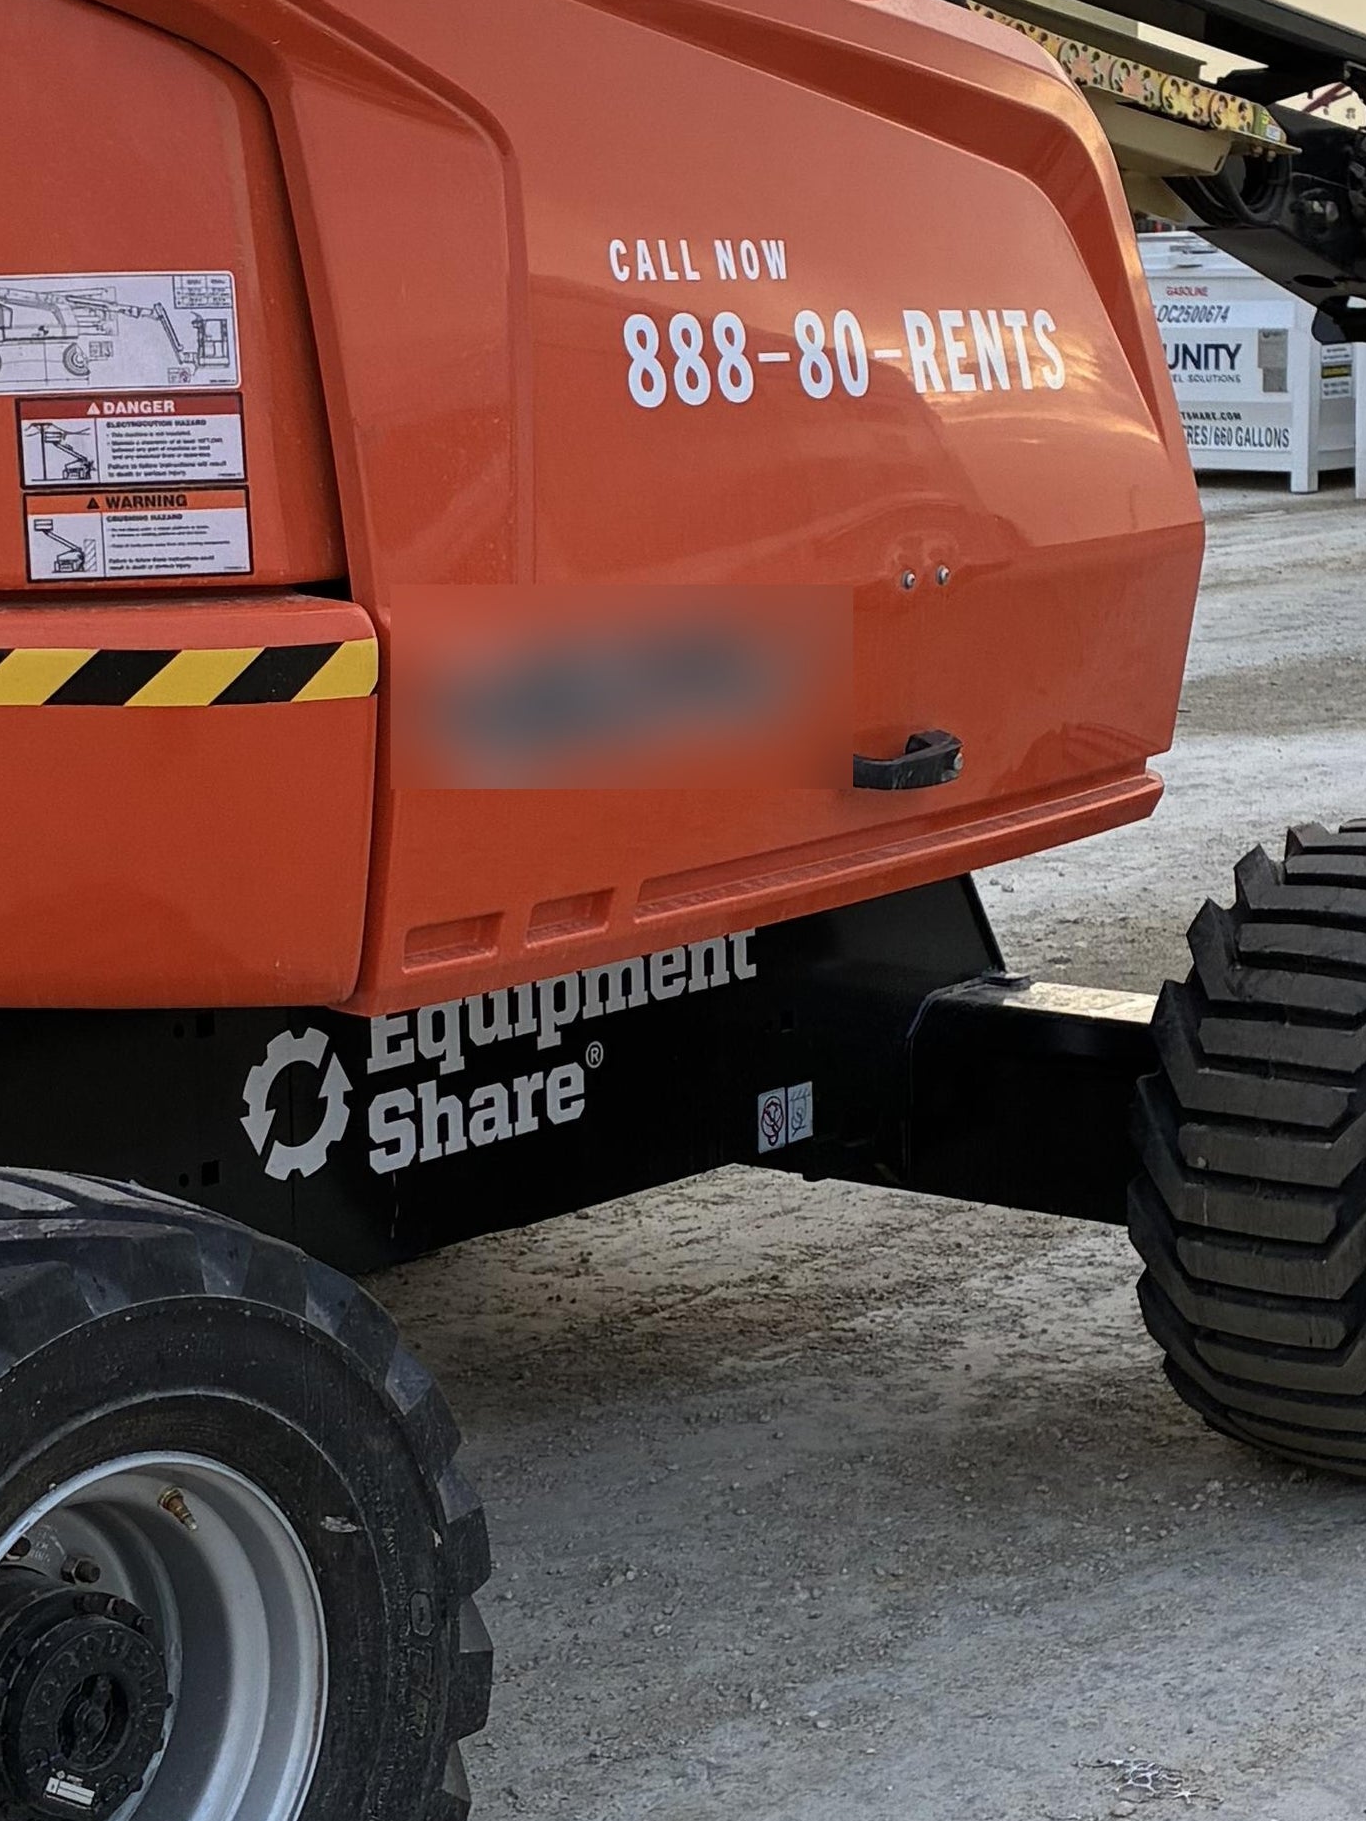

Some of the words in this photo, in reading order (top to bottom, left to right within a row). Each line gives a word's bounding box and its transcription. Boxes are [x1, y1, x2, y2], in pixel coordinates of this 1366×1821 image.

[609, 238, 701, 282] CALL
[714, 238, 789, 281] NOW
[623, 309, 1066, 409] 888-80-RENTS
[103, 399, 175, 414] DANGER
[1235, 426, 1290, 449] GALLONS
[105, 494, 188, 509] WARNING
